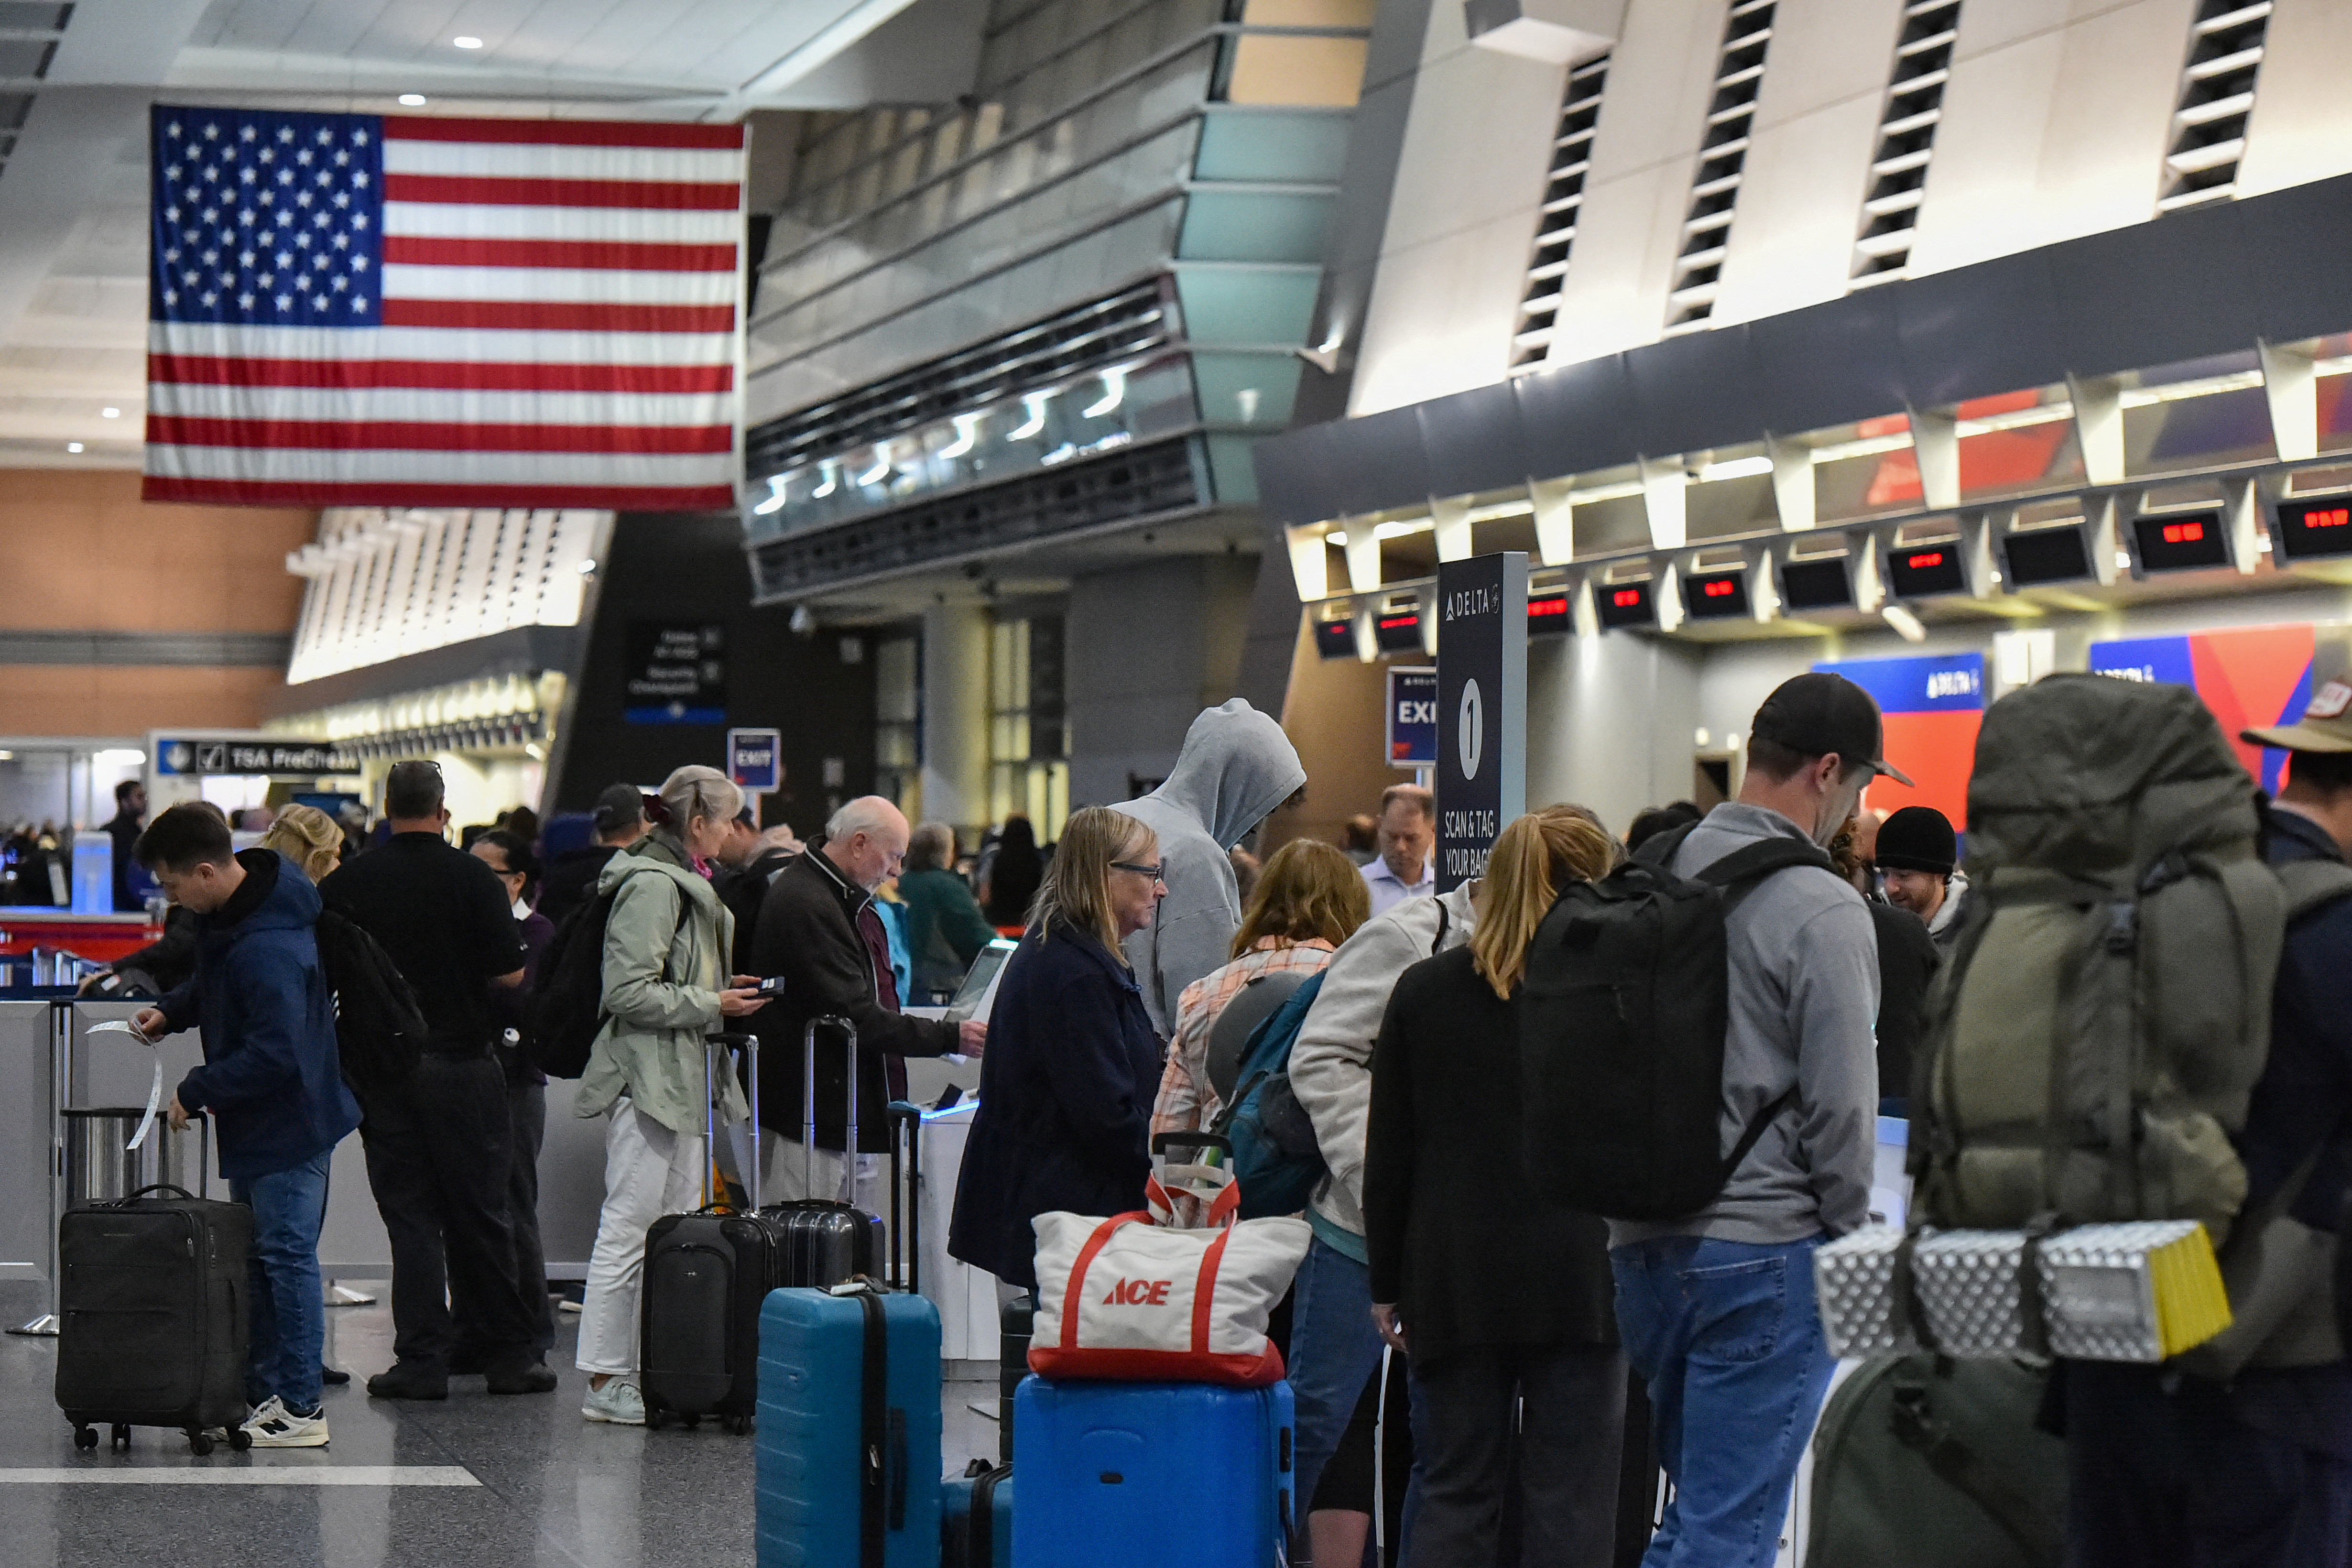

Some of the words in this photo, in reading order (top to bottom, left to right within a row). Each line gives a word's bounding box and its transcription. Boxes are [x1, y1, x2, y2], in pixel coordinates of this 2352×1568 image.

[1457, 588, 1489, 617] DELTA
[1399, 700, 1436, 724] EXI
[1468, 699, 1473, 759] 1
[1445, 811, 1466, 838] SCAN
[1468, 810, 1474, 838] &
[1476, 810, 1494, 838] TAG
[1446, 848, 1468, 876] YOUR
[1102, 1276, 1172, 1305] ACE
